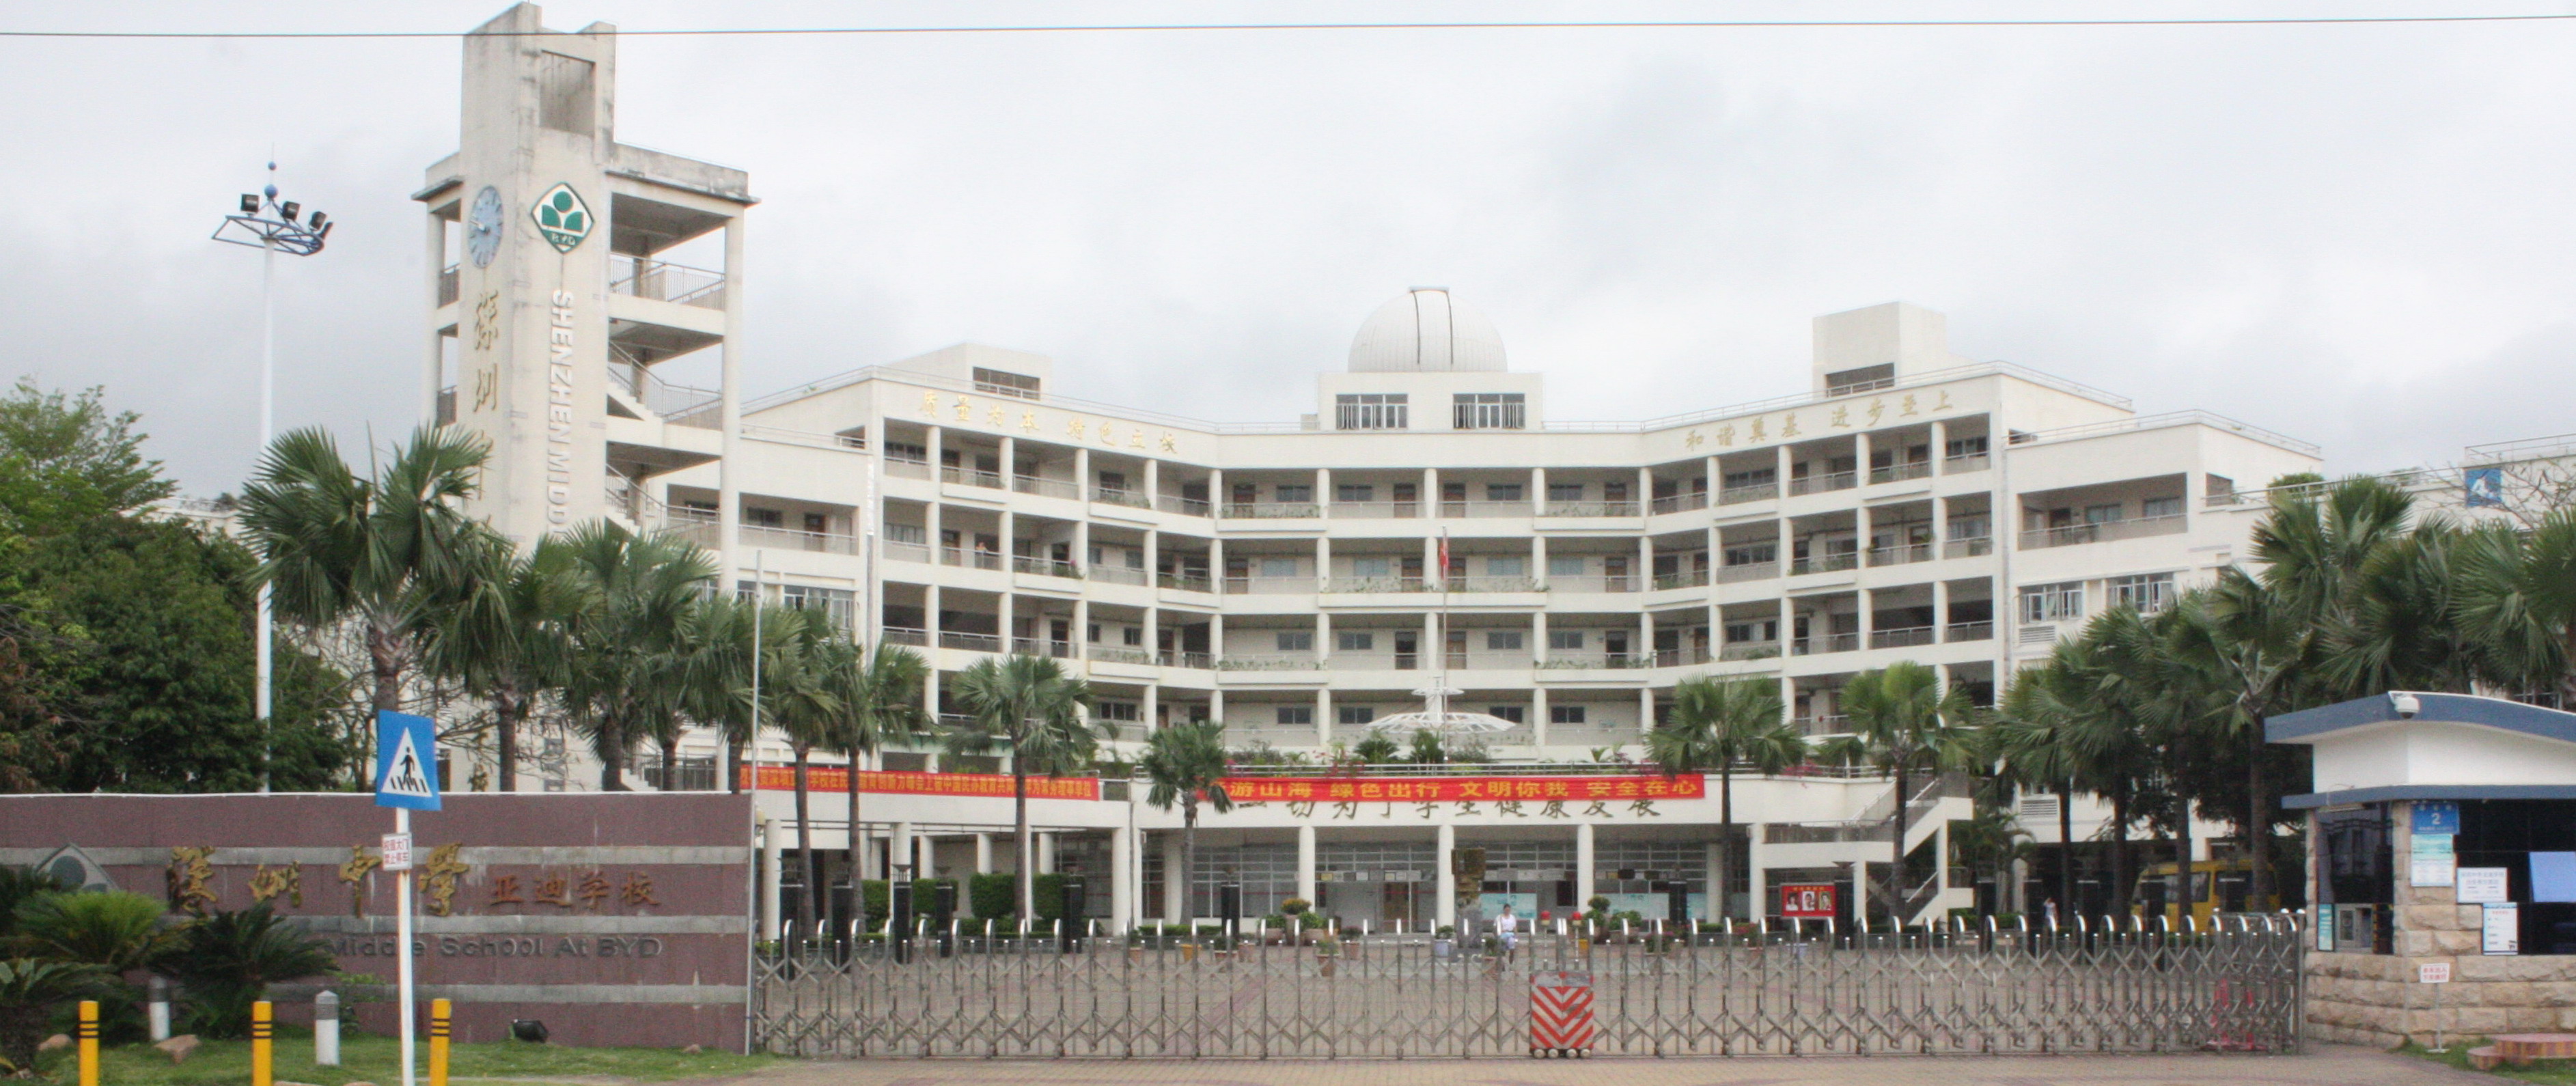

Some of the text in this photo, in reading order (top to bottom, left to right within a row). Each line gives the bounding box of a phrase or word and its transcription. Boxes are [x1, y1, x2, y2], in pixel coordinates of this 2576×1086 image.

[549, 290, 574, 443] SHENZHEN
[1329, 781, 1441, 798] 绿色出行
[1458, 781, 1569, 798] 文明你我
[1587, 780, 1698, 796] 安全在心
[2430, 812, 2441, 824] 2
[489, 871, 663, 909] 亚迪学校
[440, 936, 544, 957] School
[555, 937, 588, 956] At
[596, 936, 663, 957] BYD
